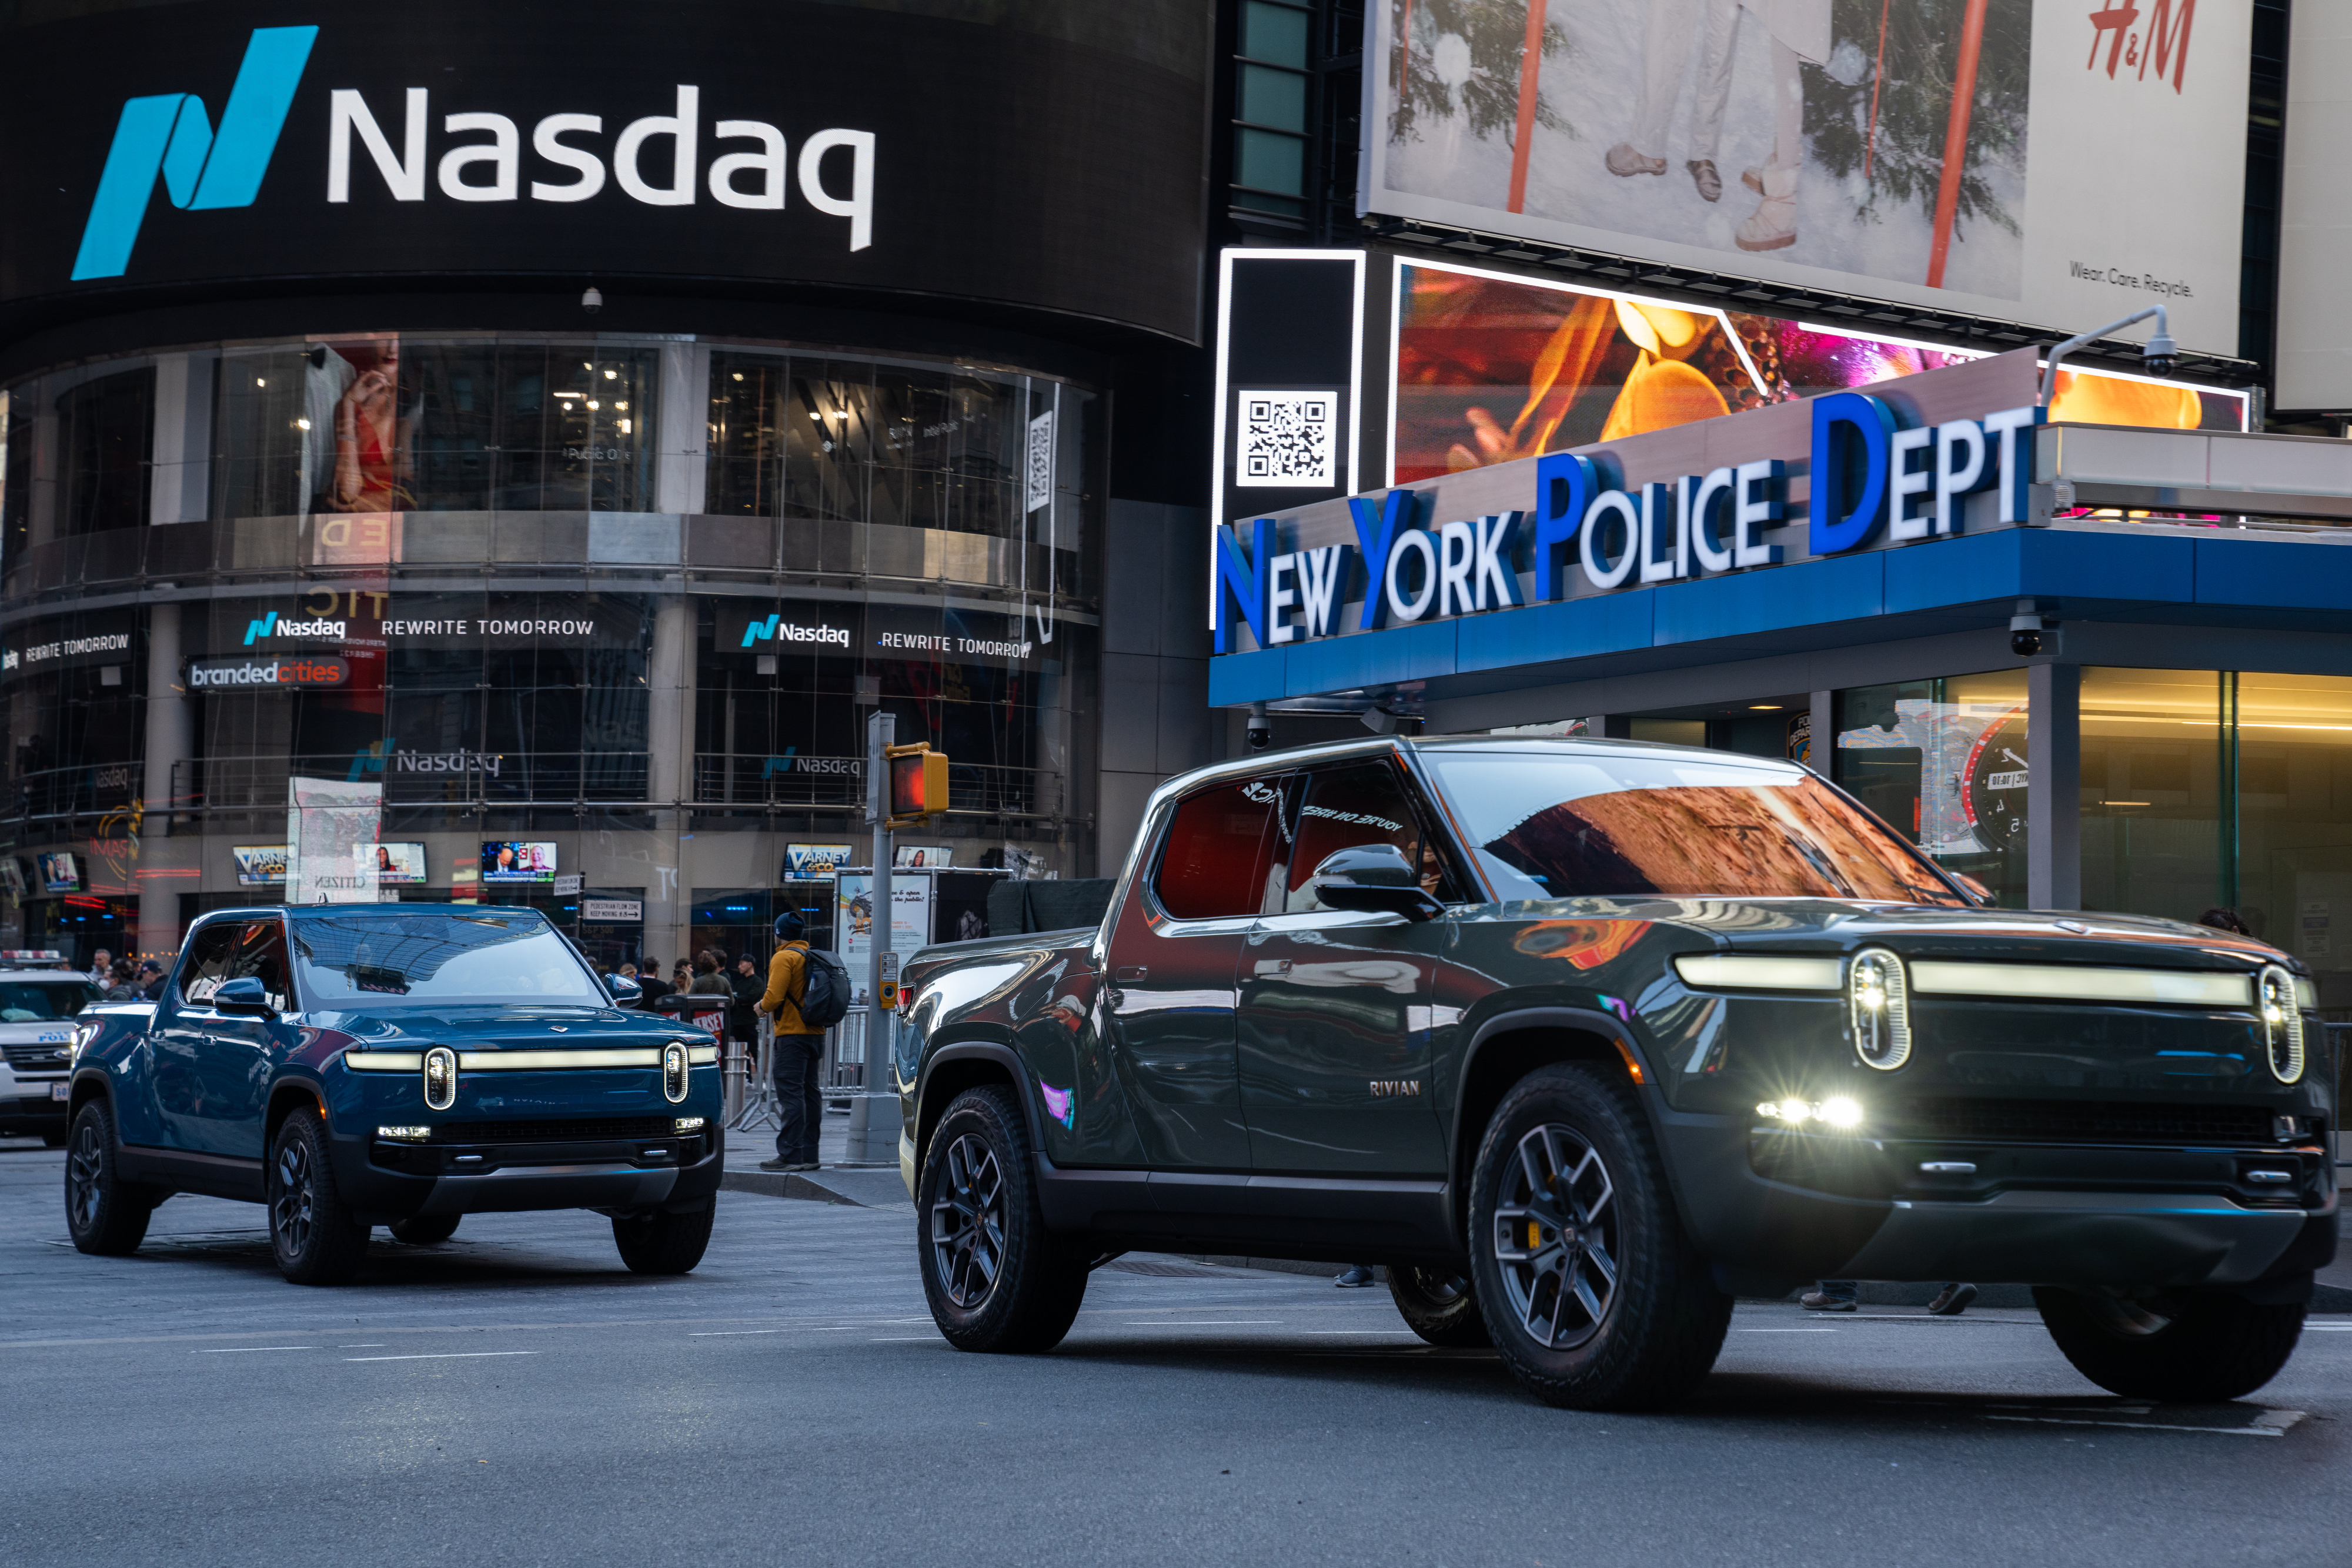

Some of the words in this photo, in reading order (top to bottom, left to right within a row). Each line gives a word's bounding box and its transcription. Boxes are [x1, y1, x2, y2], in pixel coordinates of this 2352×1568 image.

[2089, 0, 2196, 95] H&M
[327, 83, 875, 252] Nasdaq
[2069, 260, 2106, 283] Wear.
[2107, 268, 2141, 289] Care.
[2143, 273, 2194, 299] Recycle.
[1214, 519, 1352, 654] NEW
[1349, 489, 1524, 630] YORK
[1536, 453, 1784, 601] POLICE
[1810, 393, 2047, 556] DEPT
[276, 617, 346, 640] Nasdaq
[382, 620, 467, 635] REWRITE
[477, 620, 594, 635] TOMORROW
[779, 623, 849, 648] Nasdaq
[63, 634, 129, 655] TOMORROW
[882, 633, 951, 651] REWRITE
[957, 638, 1030, 658] TOMORROW
[191, 660, 340, 686] brandedcities
[397, 748, 500, 777] Nasdaq
[797, 756, 860, 778] Nasdaq
[235, 851, 287, 874] VARNE
[789, 852, 850, 871] VARNEY
[1369, 1081, 1421, 1096] RIVIAN
